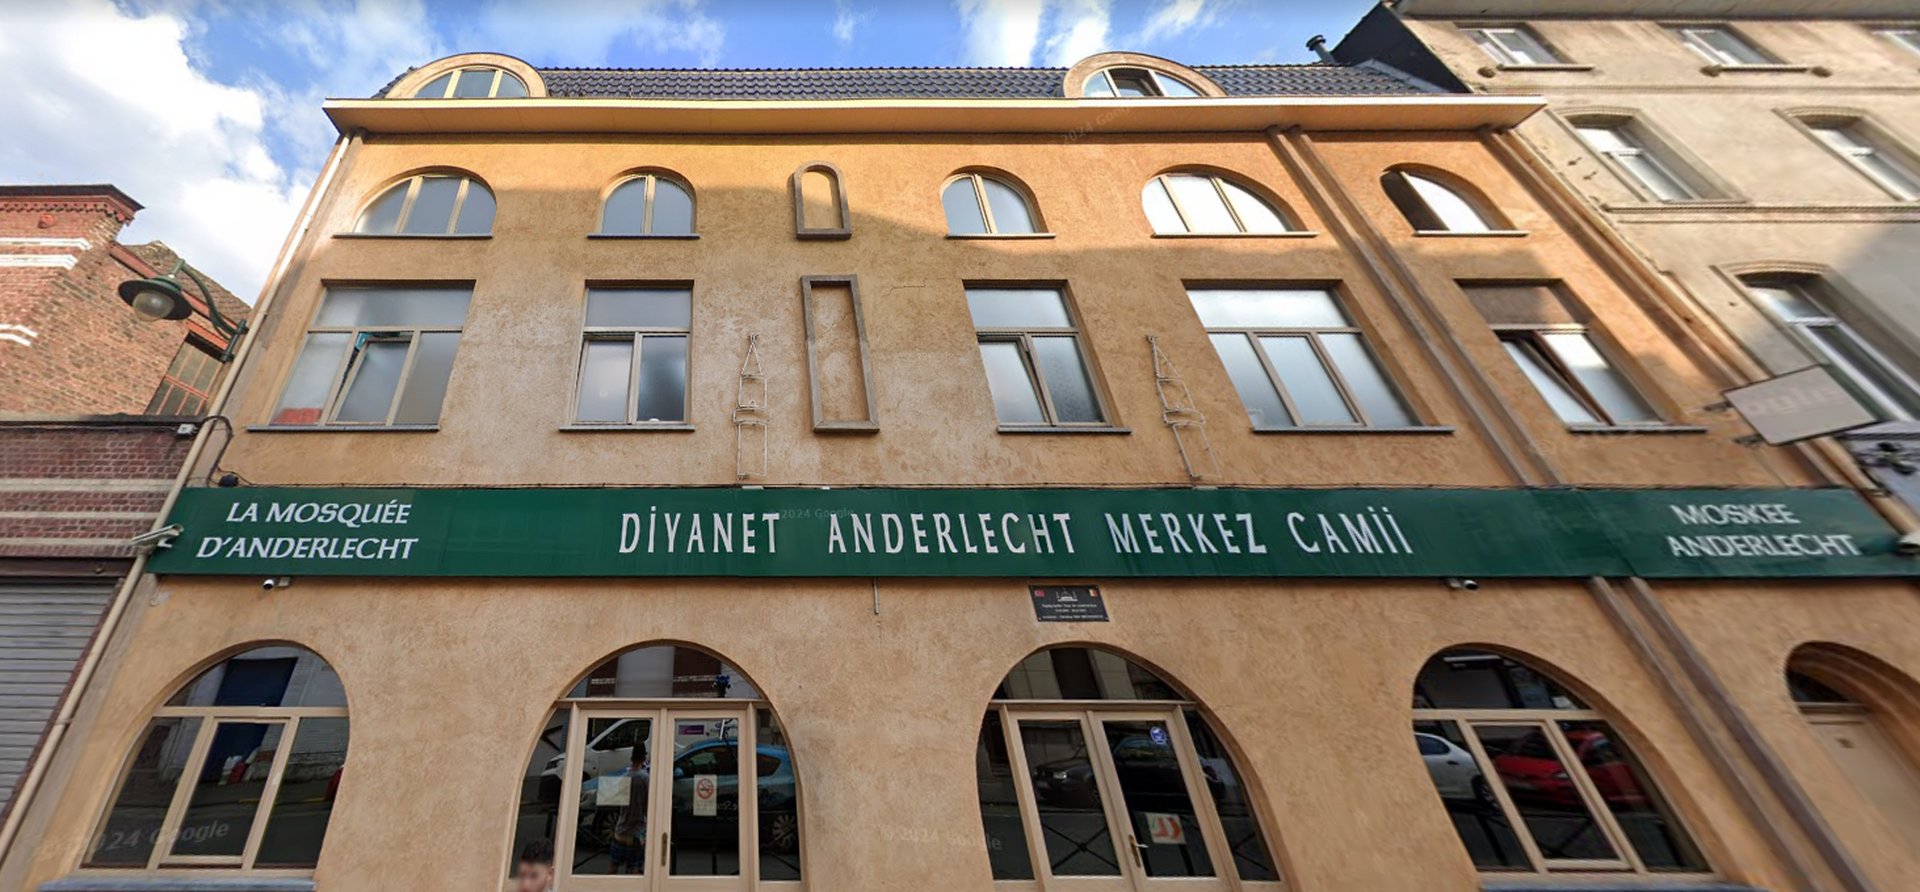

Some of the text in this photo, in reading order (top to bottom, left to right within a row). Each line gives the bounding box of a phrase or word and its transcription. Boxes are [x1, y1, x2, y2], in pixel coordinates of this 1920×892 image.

[226, 500, 412, 528] LA MOSQUÉE
[1669, 503, 1801, 525] MOSKEE
[618, 505, 780, 553] DİYANET
[828, 512, 1075, 554] ANDERLECHT
[1104, 512, 1268, 554] MERKEZ
[196, 536, 419, 560] D'ANDERLECHT
[1665, 534, 1862, 557] ANDERLECHT
